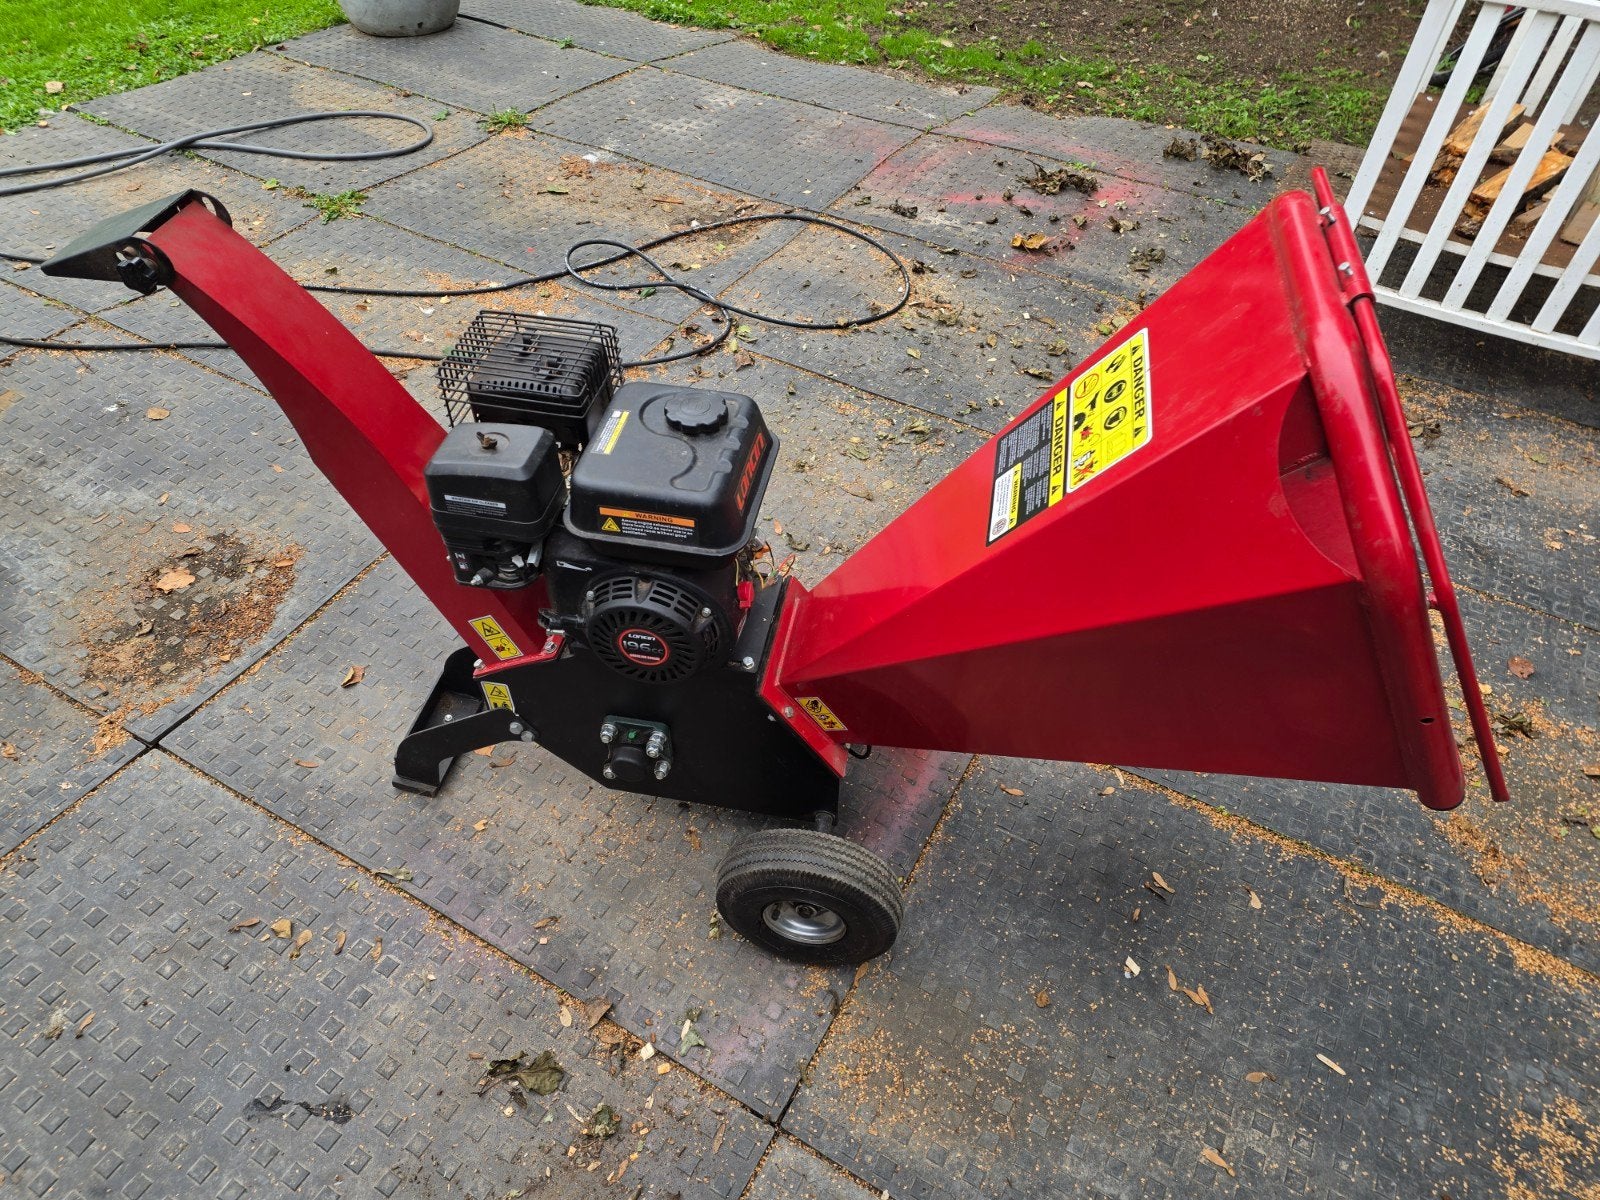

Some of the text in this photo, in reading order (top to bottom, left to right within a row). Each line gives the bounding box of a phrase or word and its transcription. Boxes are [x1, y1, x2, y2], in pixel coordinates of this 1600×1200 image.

[1133, 356, 1145, 421] DANGER
[1053, 415, 1064, 477] DANGER
[635, 513, 673, 523] WARNING
[1011, 479, 1019, 513] WARNING
